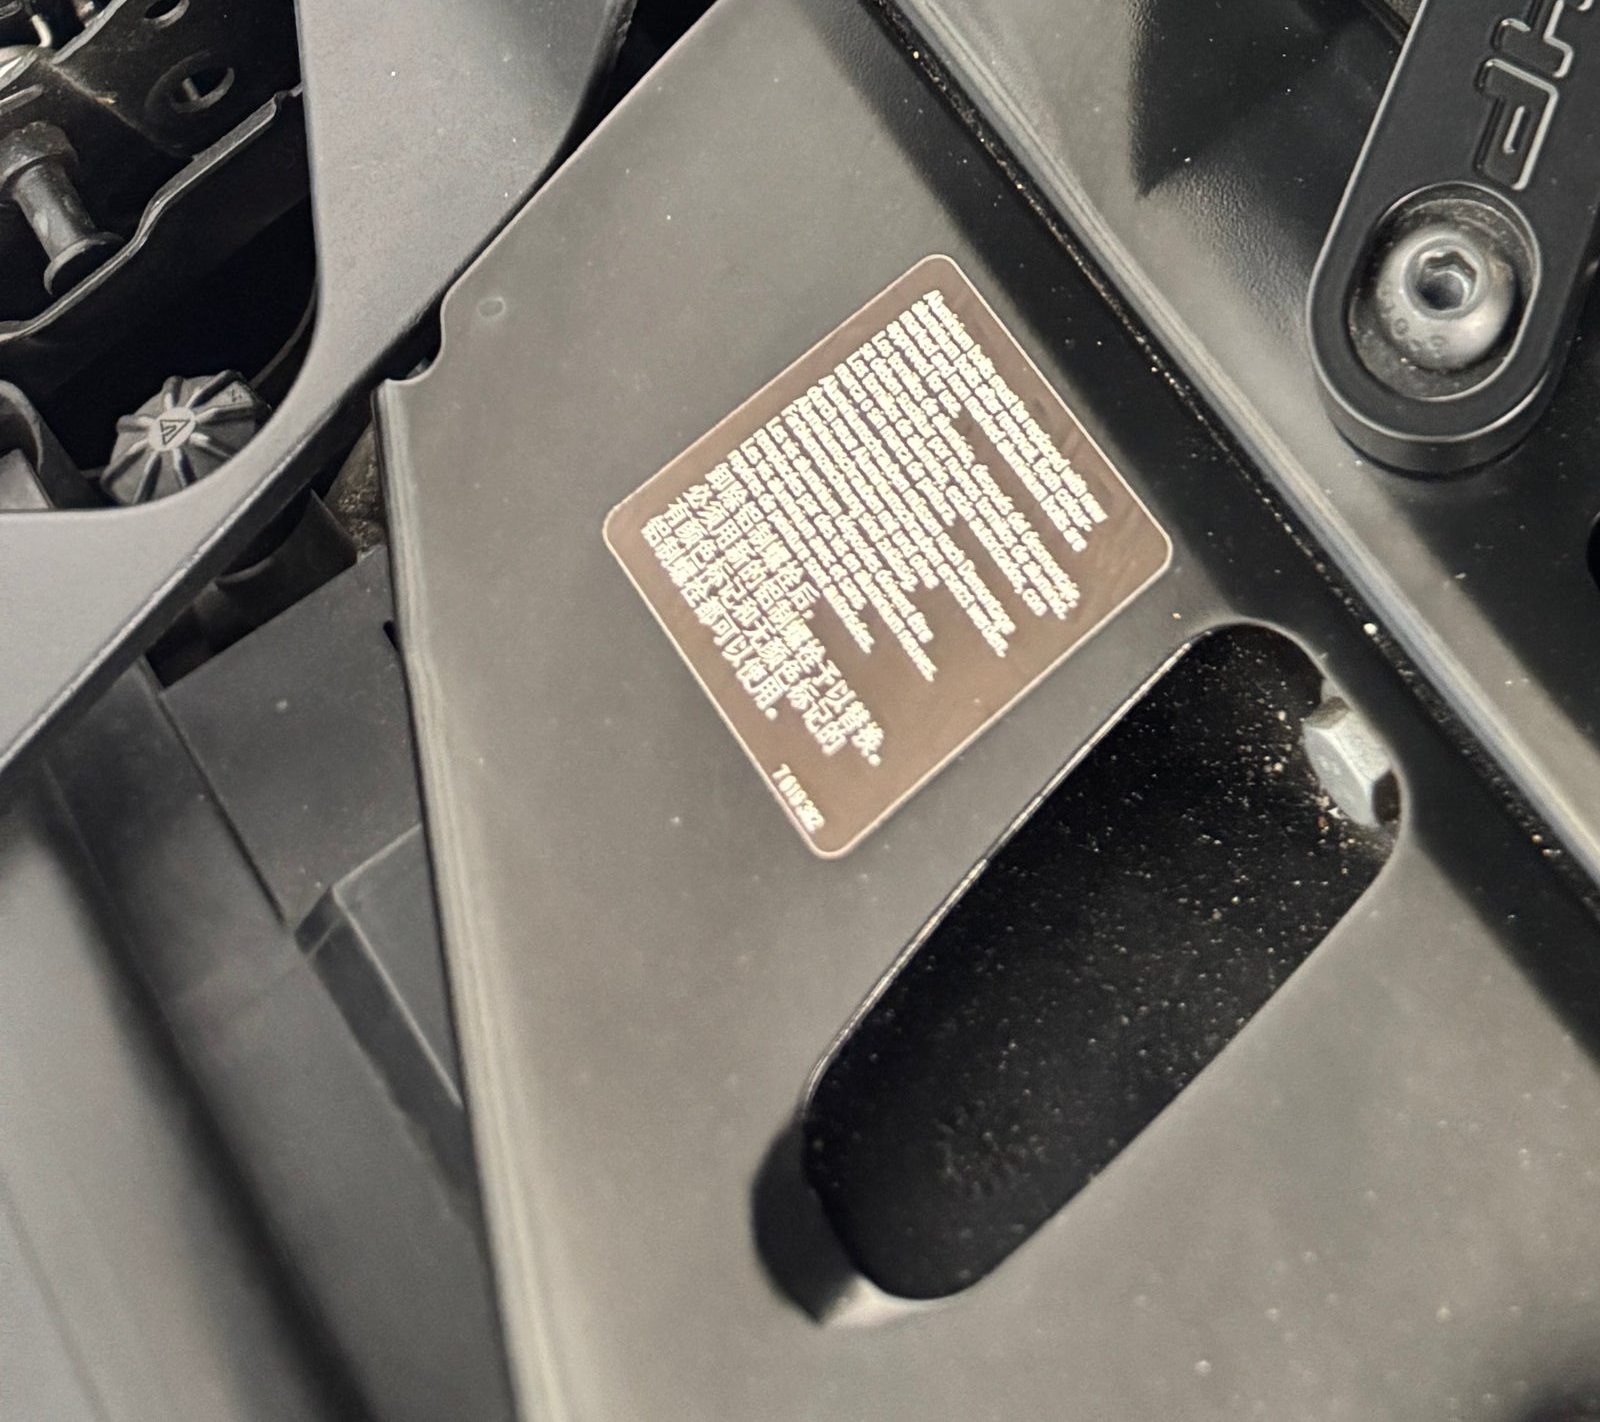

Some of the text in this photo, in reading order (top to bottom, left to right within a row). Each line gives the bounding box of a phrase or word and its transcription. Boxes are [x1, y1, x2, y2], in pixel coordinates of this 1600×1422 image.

[832, 362, 868, 403] marca
[865, 406, 887, 430] sin
[878, 424, 914, 466] marca
[868, 356, 903, 396] deben
[926, 435, 953, 460] por
[943, 455, 986, 504] nuevos
[974, 495, 1018, 549] tornillos
[870, 329, 896, 360] Los
[883, 350, 928, 402] tornillos
[1002, 510, 1032, 535] del
[883, 319, 935, 377] approved
[924, 369, 947, 393] for
[897, 309, 1088, 552] marked and non marked aluminium bolts are
[910, 299, 961, 360] aluminium
[952, 352, 983, 389] bolts
[973, 382, 1004, 414] after
[1031, 456, 1062, 492] Both
[921, 289, 974, 351] Aluminium
[963, 343, 996, 380] bolts
[987, 373, 1019, 409] must
[1021, 417, 1071, 472] replaced
[1058, 465, 1088, 500] with
[1078, 491, 1108, 523] new
[738, 436, 763, 465] Les
[753, 456, 775, 482] vis
[765, 476, 816, 540] aluminium
[807, 534, 837, 568] avec
[837, 575, 867, 614] sans
[764, 415, 789, 444] Les
[780, 437, 801, 460] vis
[791, 454, 842, 518] aluminium
[873, 568, 916, 618] doivent
[766, 508, 811, 561] peinture
[802, 555, 832, 589] sont
[792, 394, 940, 589] Aluminiumschrauben mit und ohne
[795, 491, 823, 517] par
[812, 512, 837, 540] des
[829, 533, 850, 557] vis
[852, 568, 905, 634] aluminium
[805, 384, 838, 423] durch
[829, 416, 858, 451] neue
[849, 445, 944, 567] Aluminiumschrauben
[817, 374, 910, 493] Aluminiumschrauben
[934, 531, 965, 566] nach
[956, 558, 1016, 635] Demontage
[845, 349, 870, 378] Los
[861, 371, 903, 423] tornillos
[1021, 587, 1048, 617] con
[856, 511, 887, 543] sind
